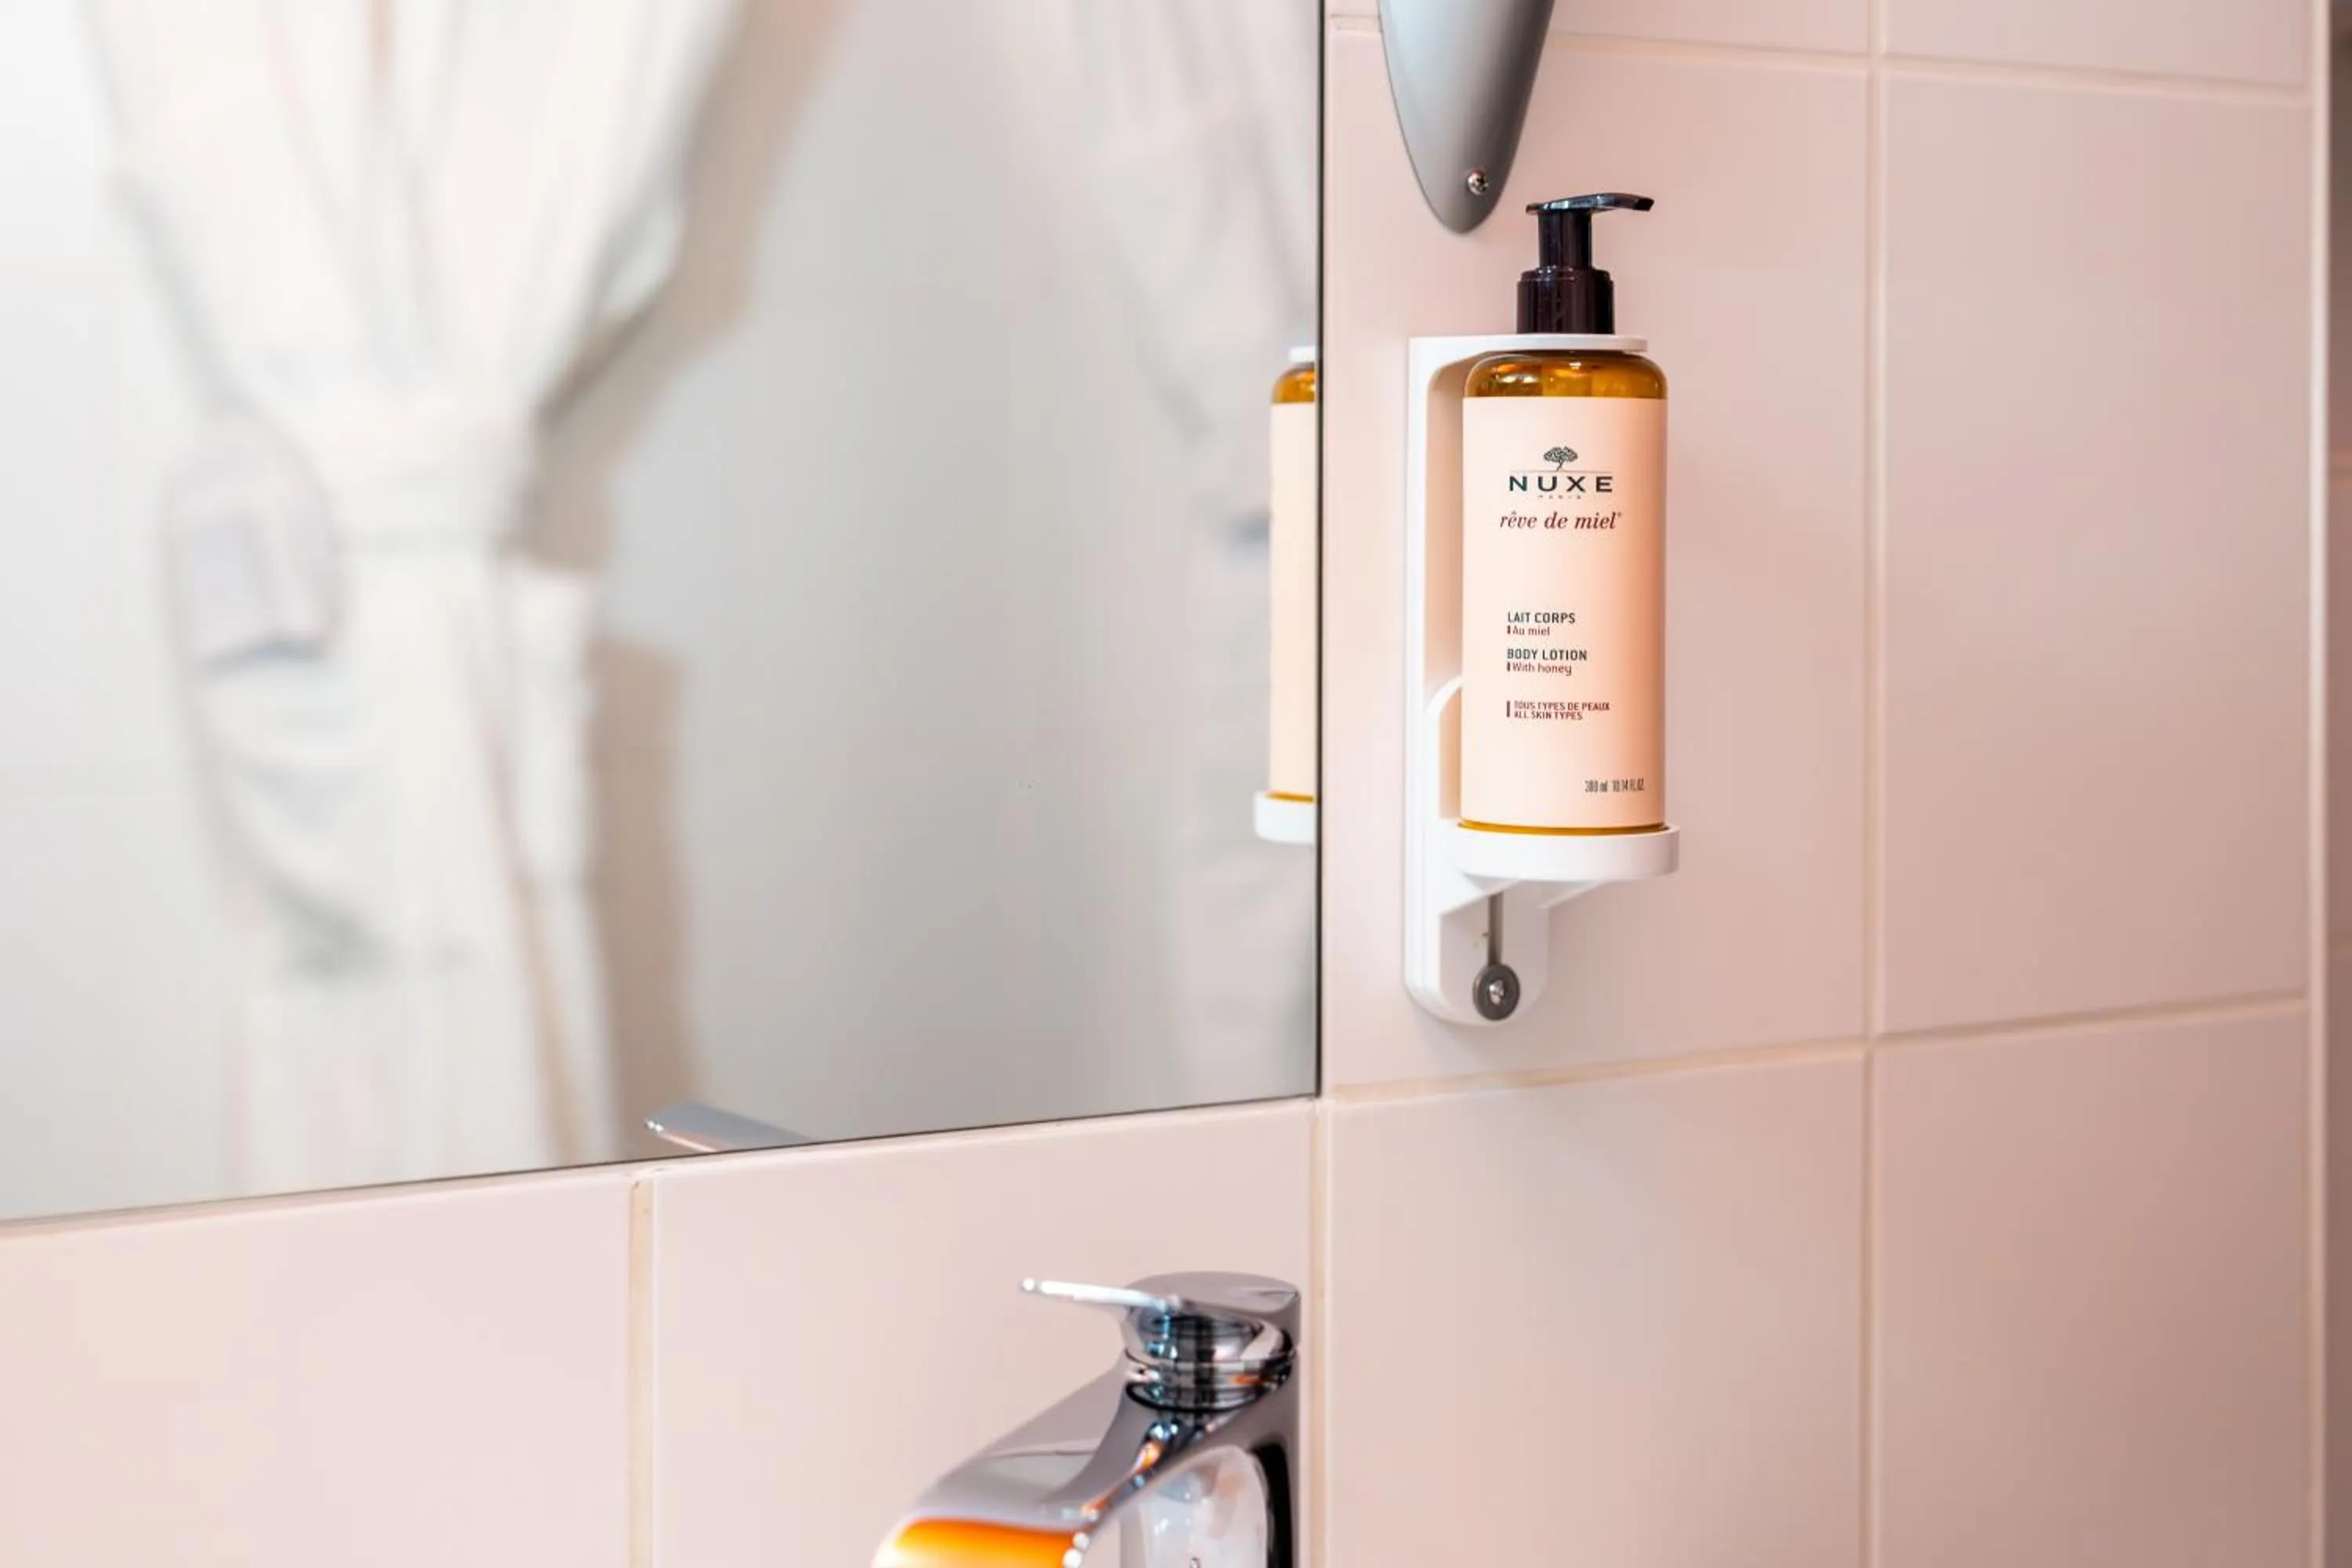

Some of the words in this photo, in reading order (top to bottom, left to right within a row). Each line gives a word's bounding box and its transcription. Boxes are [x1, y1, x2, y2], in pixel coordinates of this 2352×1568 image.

[1508, 475, 1613, 492] NUXE
[1500, 511, 1537, 528] rêve
[1544, 511, 1569, 529] de
[1508, 612, 1530, 623] LAIT
[1534, 612, 1576, 624] CORPS
[1512, 626, 1525, 636] Au
[1528, 626, 1551, 637] miel
[1507, 648, 1538, 660] BODY
[1542, 649, 1588, 661] LOTION
[1512, 662, 1535, 673] With
[1537, 663, 1573, 677] honey
[1567, 702, 1579, 711] DE
[1581, 702, 1611, 712] PEAUX
[1531, 711, 1552, 720] SKIN
[1555, 711, 1583, 720] TYPES
